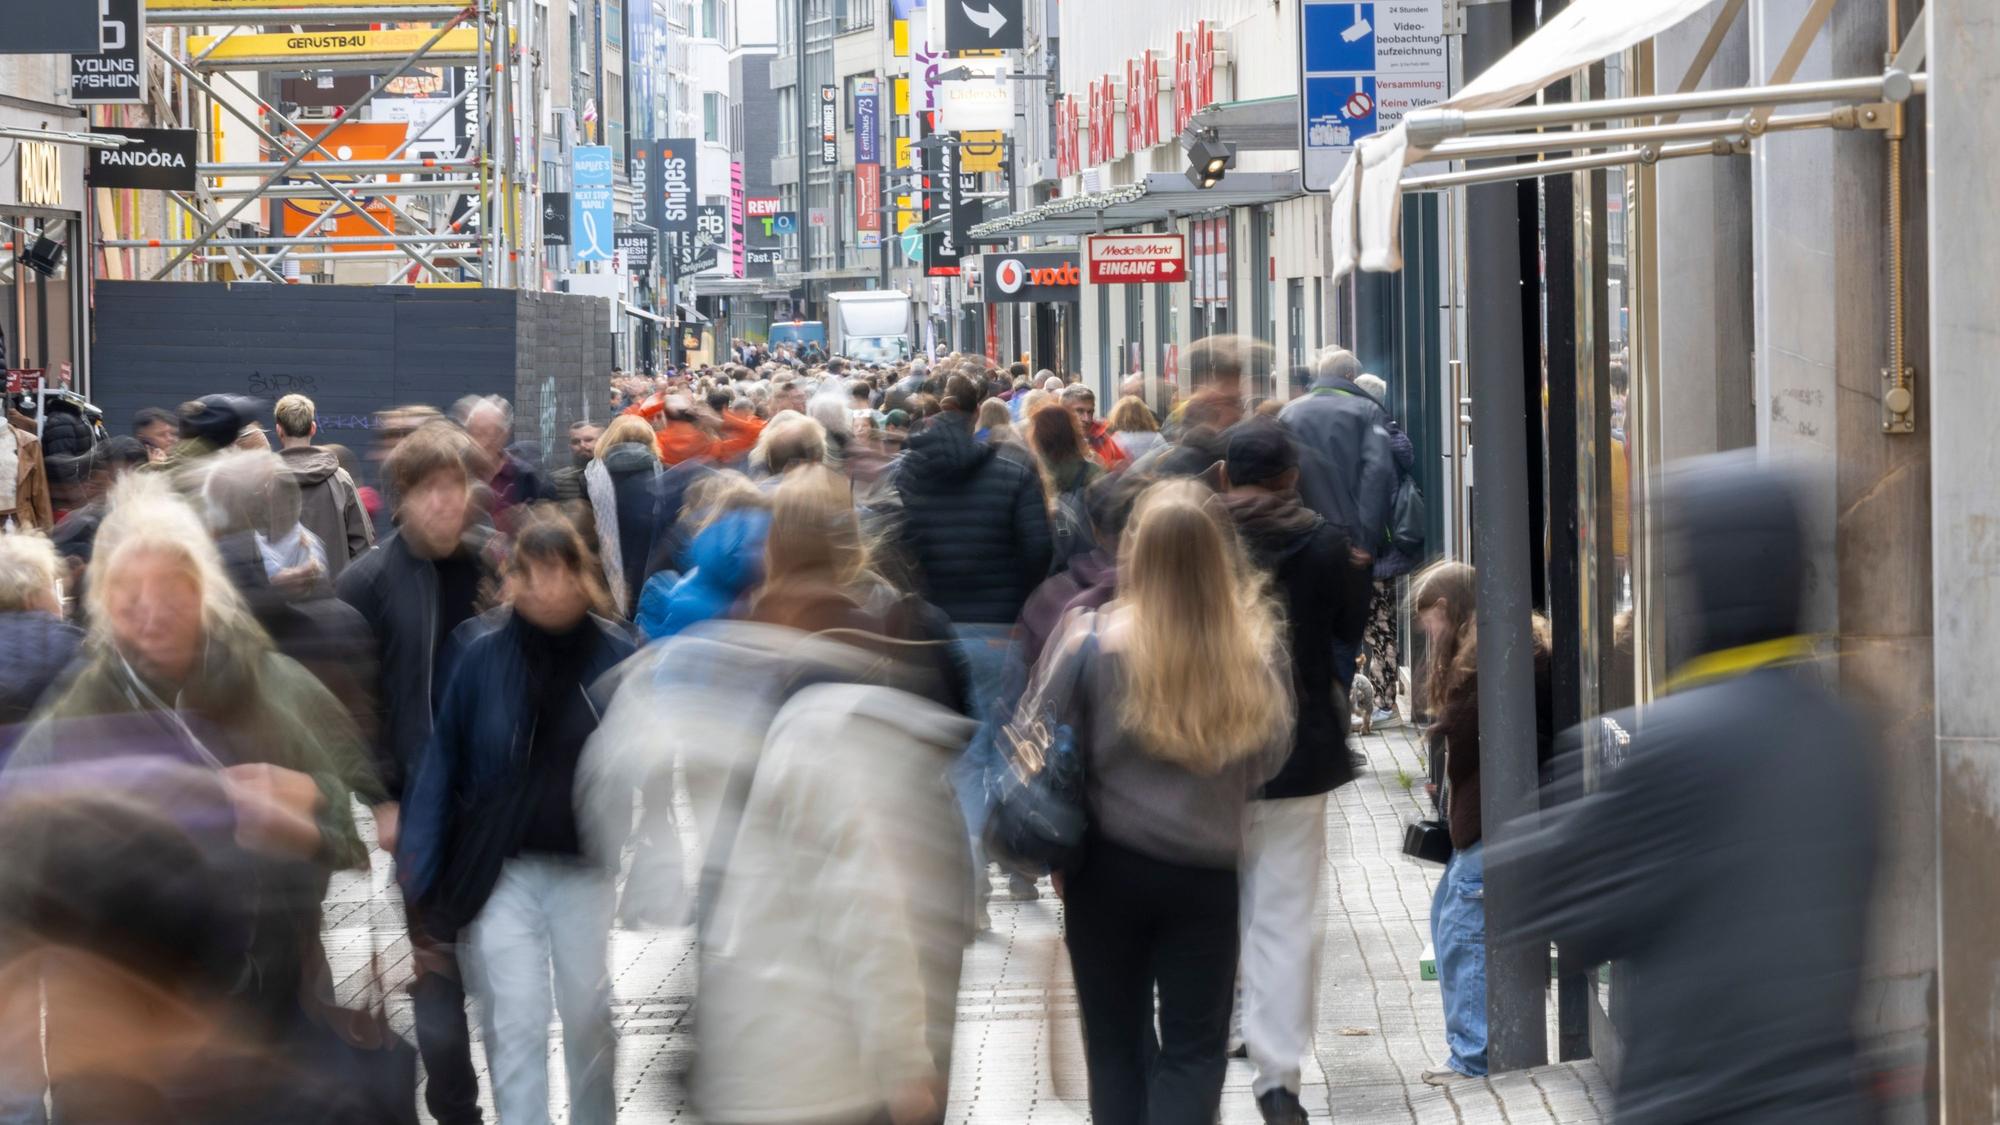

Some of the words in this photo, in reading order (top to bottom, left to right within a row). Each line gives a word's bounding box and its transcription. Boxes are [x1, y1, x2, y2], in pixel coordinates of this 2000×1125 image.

[1393, 22, 1425, 31] Video-
[1377, 47, 1443, 56] aufzeichnung
[75, 58, 135, 72] YOUNG
[71, 74, 140, 88] FASHION
[1376, 80, 1445, 89] Versammlung:
[858, 98, 873, 114] 73
[823, 104, 834, 136] KORNER
[100, 148, 186, 168] PANDORA
[824, 142, 836, 162] FOOT
[664, 157, 690, 221] snipes
[617, 238, 648, 247] LUSH
[623, 247, 648, 255] RESH
[747, 252, 771, 263] Fast.
[1098, 261, 1156, 276] EINGANG
